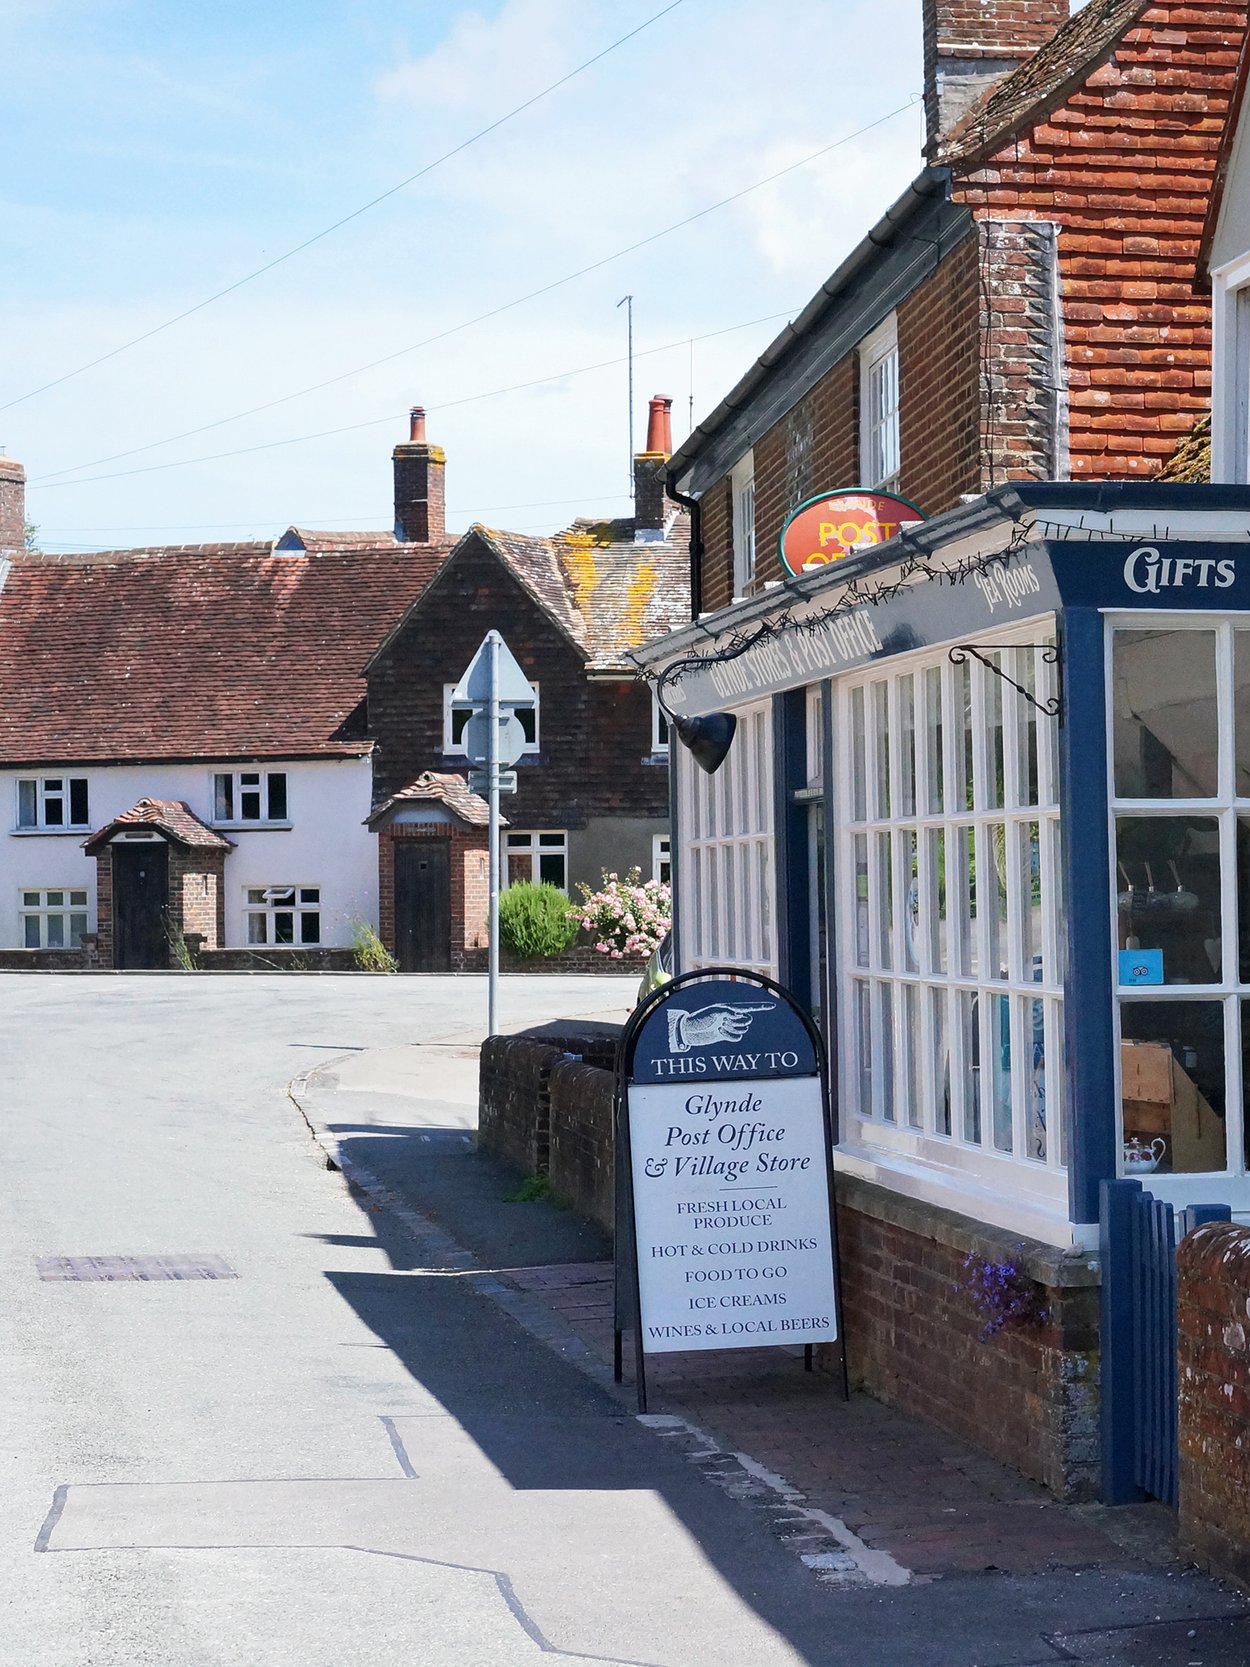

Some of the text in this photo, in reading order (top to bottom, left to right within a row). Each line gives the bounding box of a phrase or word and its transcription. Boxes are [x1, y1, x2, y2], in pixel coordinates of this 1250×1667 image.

[819, 521, 897, 547] POST
[1123, 546, 1236, 594] GIFTS
[709, 655, 754, 699] GLYNDE
[744, 641, 793, 688] STORES
[784, 634, 806, 676] &
[797, 628, 837, 671] POST
[829, 609, 884, 661] OFFICE
[650, 1051, 799, 1076] THIS WAY TO
[684, 1093, 763, 1122] Glynde
[664, 1123, 786, 1151] Post Office
[644, 1152, 811, 1182] & Village Store
[676, 1197, 788, 1215] FRESH LOCAL
[693, 1214, 773, 1230] PRODUCE
[651, 1237, 818, 1258] HOT & COLD DRINKS
[684, 1265, 788, 1283] FOOD TO GO
[688, 1292, 788, 1310] ICE CREAMS
[648, 1316, 831, 1339] WINES & LOCAL BEERS
